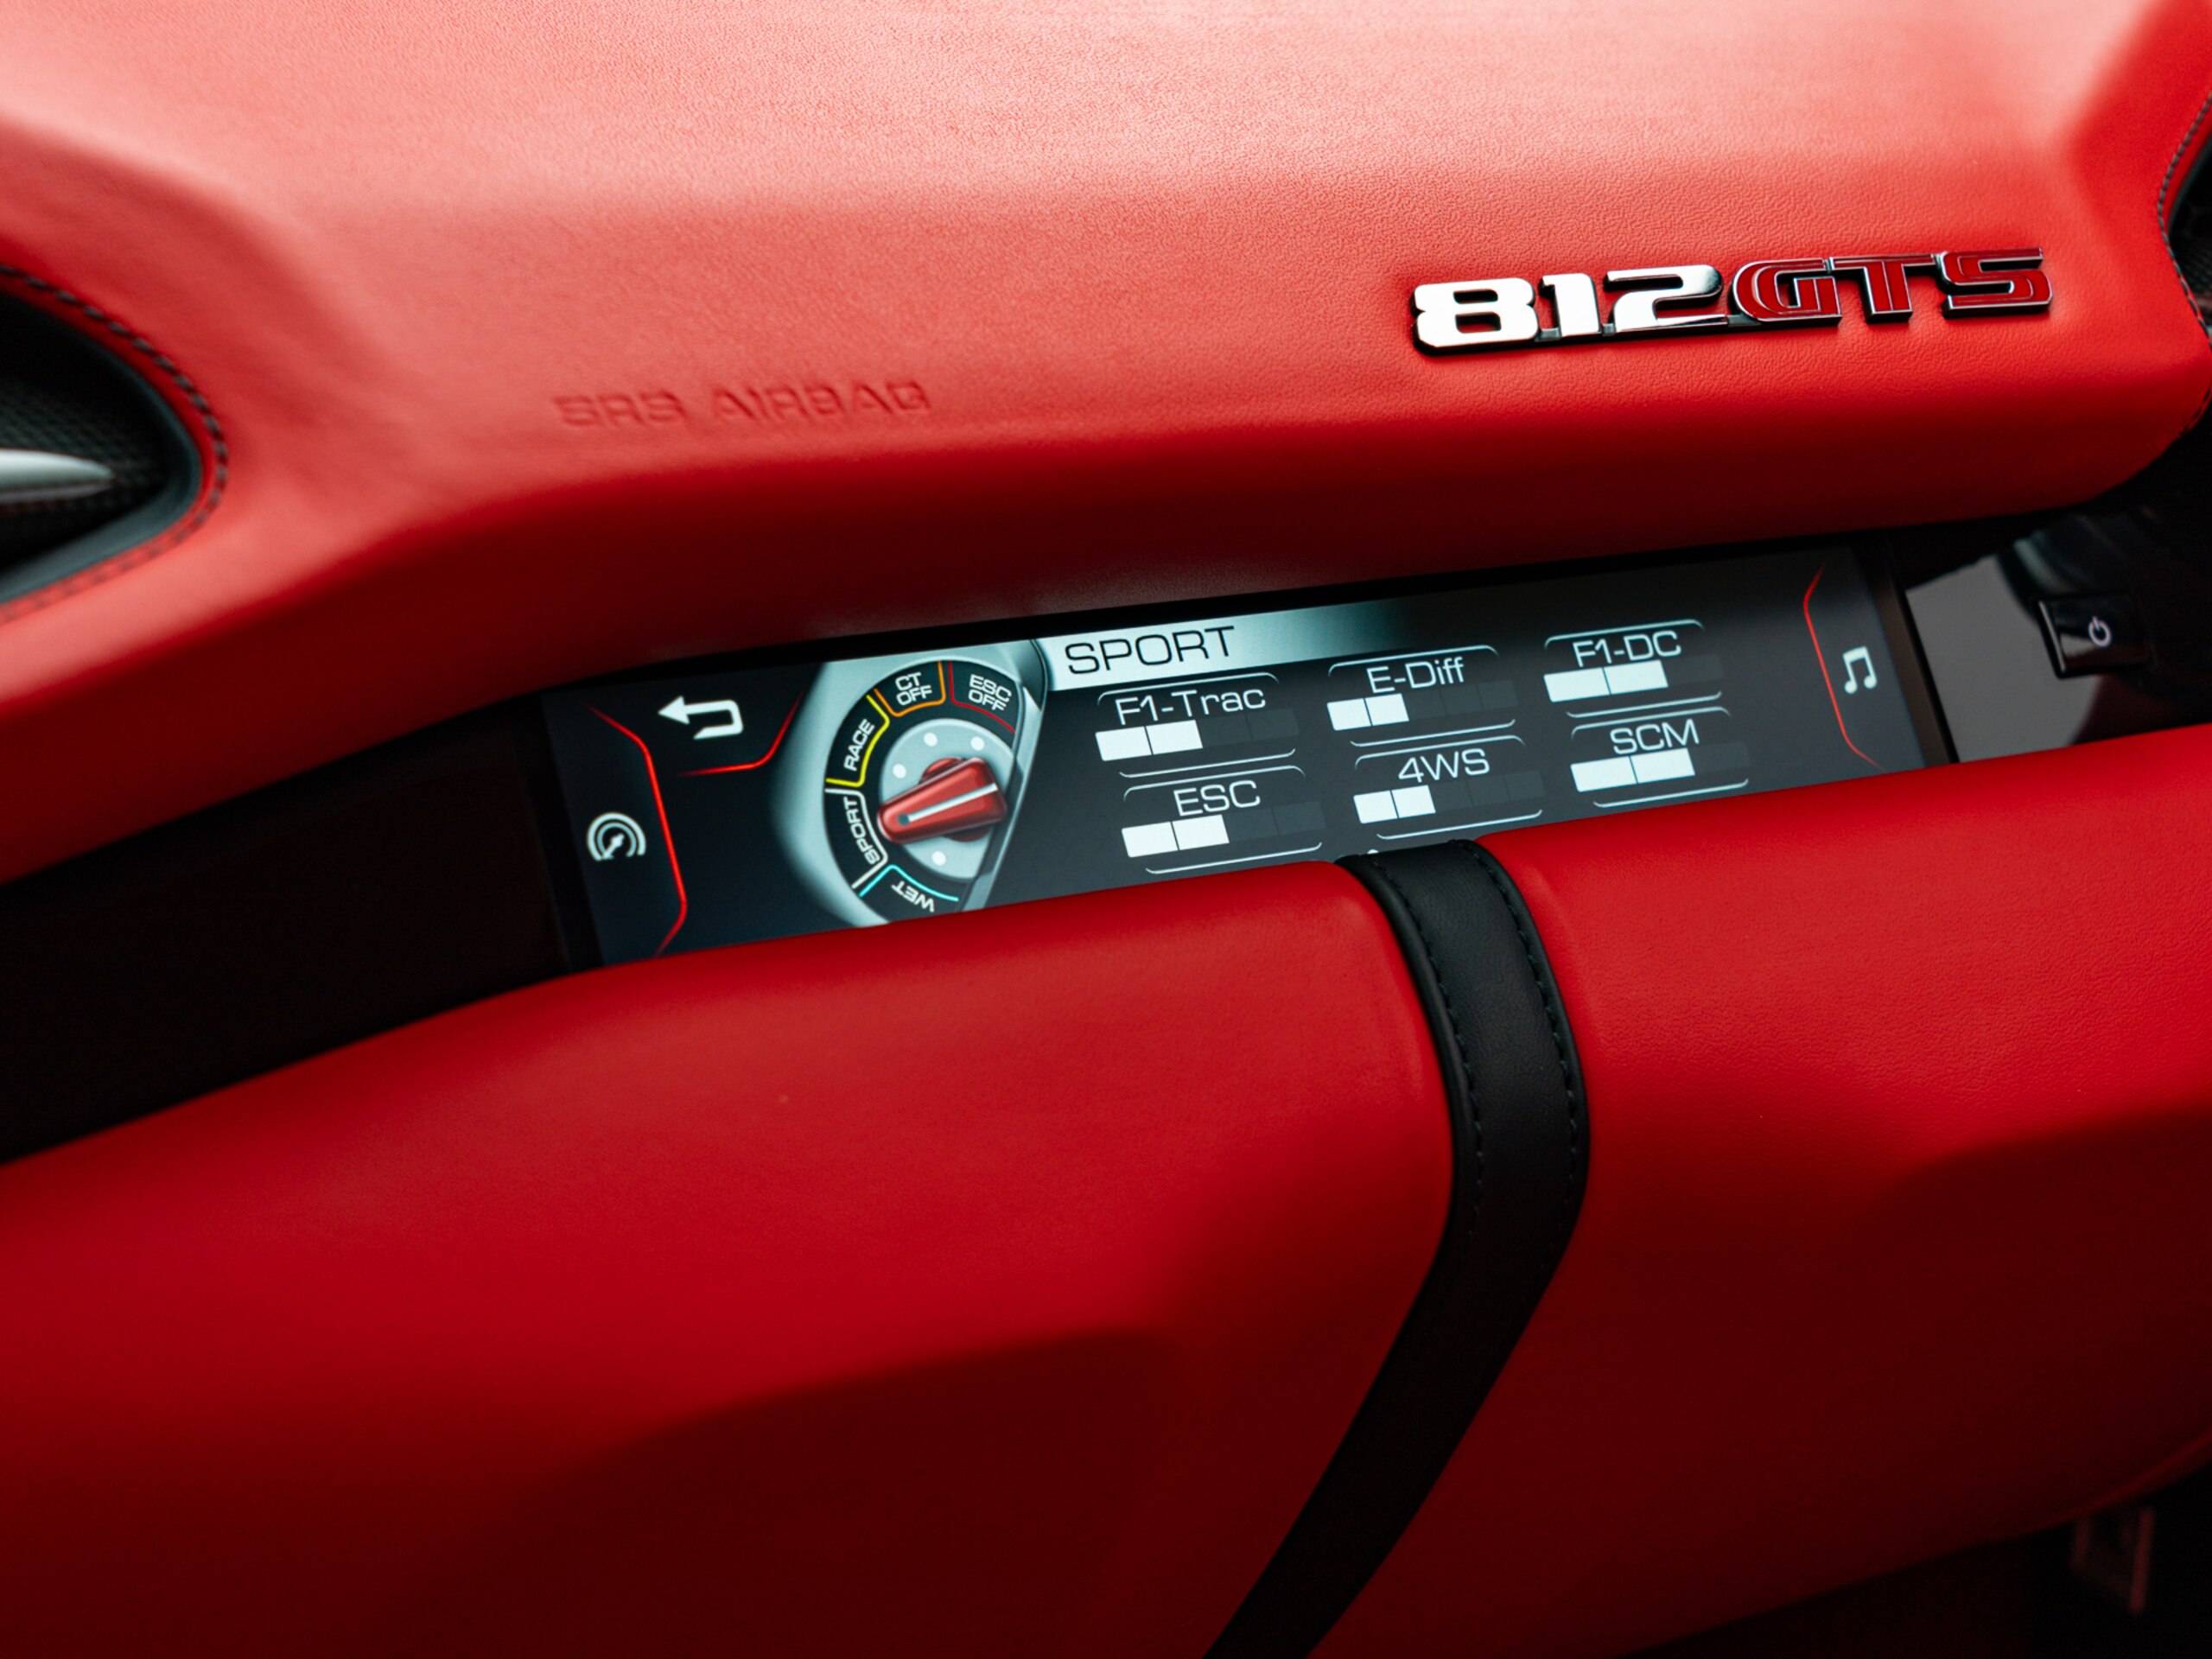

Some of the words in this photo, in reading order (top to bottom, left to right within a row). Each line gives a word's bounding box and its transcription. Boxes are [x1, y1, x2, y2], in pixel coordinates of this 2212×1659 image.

[553, 389, 690, 429] SRS
[711, 380, 931, 424] AIRBAG
[1065, 625, 1236, 675] SPORT
[1573, 630, 1681, 668] F1-DC
[895, 671, 922, 690] CT
[969, 673, 1012, 702] ESC
[1366, 657, 1465, 694] E-Diff
[896, 683, 933, 706] OFF
[968, 690, 1007, 713] OFF
[1115, 688, 1266, 726] F1-Trac
[843, 718, 875, 772] RACE
[1610, 718, 1700, 755] SCM
[1397, 747, 1491, 783] 4WS
[1173, 779, 1262, 817] ESC
[843, 796, 881, 865] SPORT
[891, 880, 936, 912] WET
